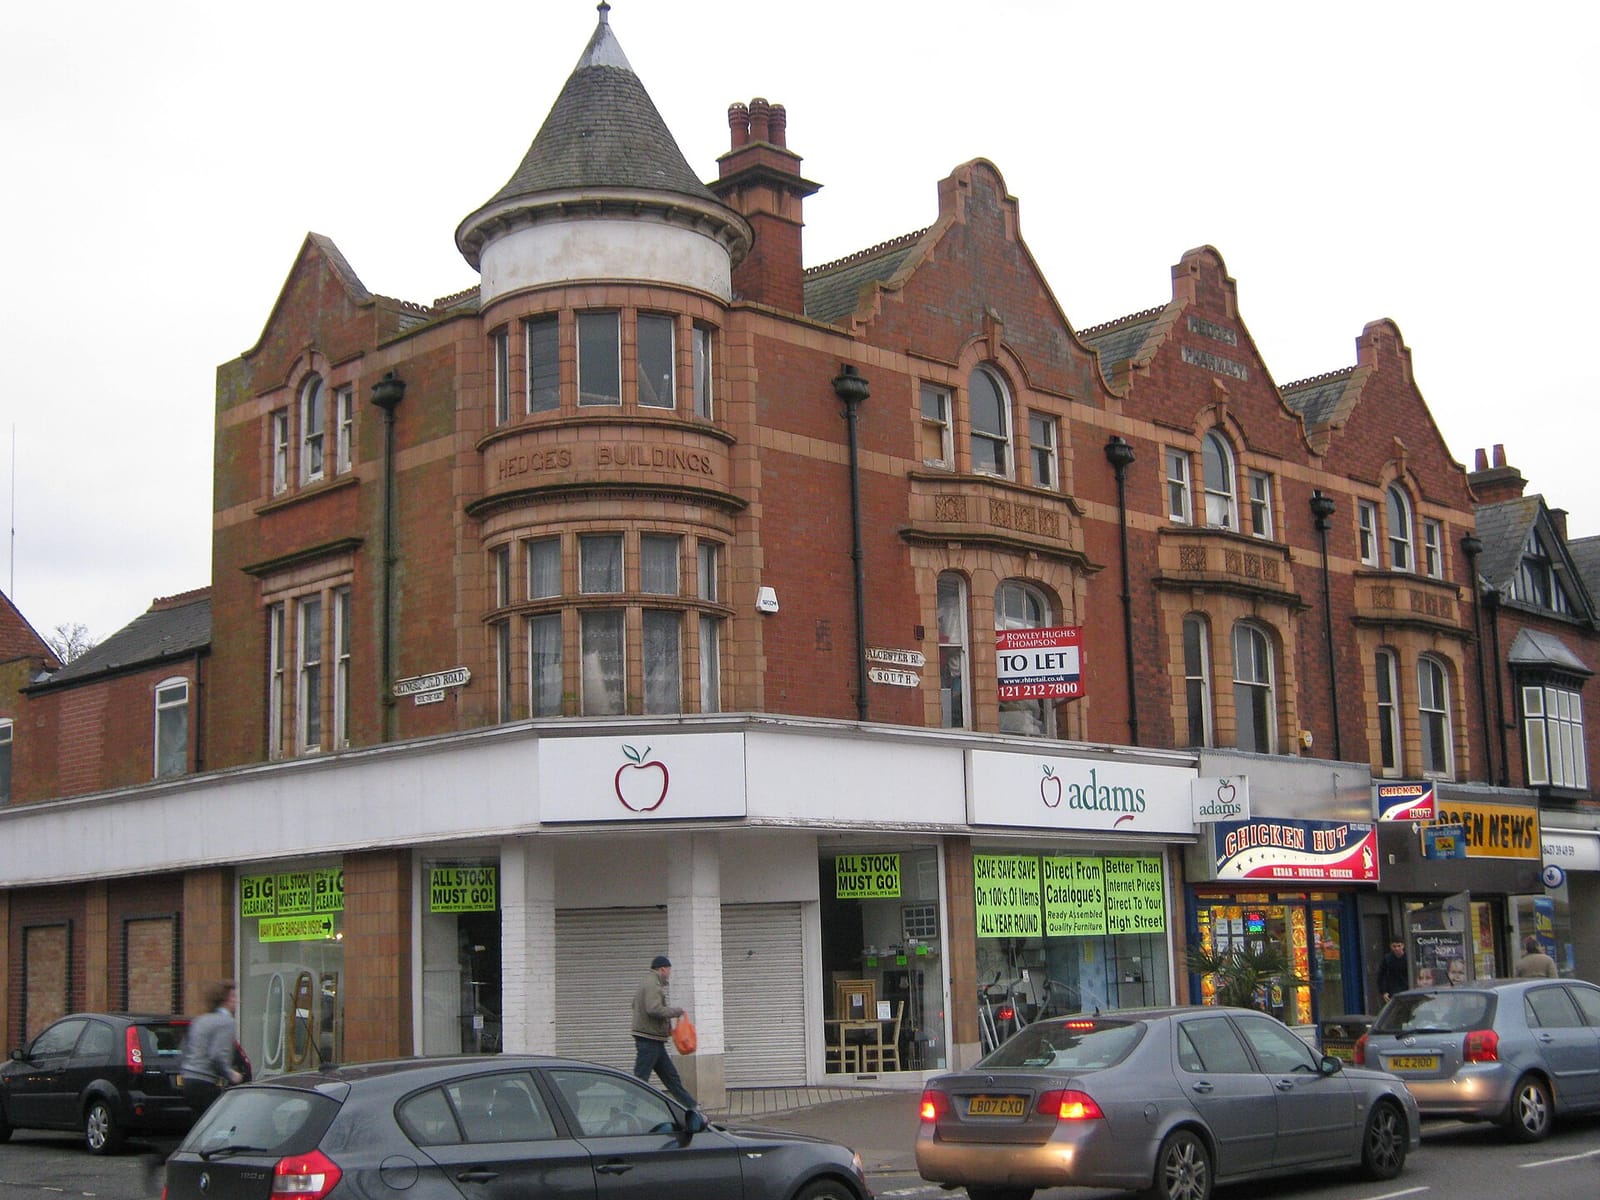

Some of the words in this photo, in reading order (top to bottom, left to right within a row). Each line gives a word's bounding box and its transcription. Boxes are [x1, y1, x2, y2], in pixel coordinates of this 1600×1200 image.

[498, 450, 572, 479] HEDGES
[1006, 631, 1040, 641] ROWLEY
[1042, 630, 1076, 639] HUGHES
[1007, 639, 1057, 648] THOMPSON
[1000, 654, 1028, 672] TO
[1035, 652, 1067, 670] LET
[398, 676, 440, 694] KINGSELD
[443, 672, 464, 685] ROAD
[877, 671, 911, 685] SOUTH
[1024, 684, 1045, 697] 212
[1049, 682, 1078, 695] 7800
[1069, 768, 1146, 813] adams
[1380, 785, 1422, 797] CHICKEN
[1199, 800, 1241, 816] adams
[1409, 808, 1432, 818] HUT
[1489, 813, 1533, 849] NEWS
[1225, 823, 1305, 858] CHICKEN
[1312, 824, 1348, 851] HUT
[838, 857, 857, 872] ALL
[861, 856, 897, 872] STOCK
[977, 860, 995, 878] SAVE
[998, 860, 1015, 879] SAVE
[1018, 861, 1036, 879] SAVE
[1045, 861, 1073, 879] Direct
[1076, 861, 1100, 879] From
[1106, 860, 1134, 873] Better
[1136, 860, 1159, 873] Than
[280, 876, 289, 890] ALL
[291, 873, 310, 889] STOCK
[433, 871, 452, 886] ALL
[456, 869, 493, 885] STOCK
[839, 875, 872, 890] MUST
[876, 874, 897, 889] GO!
[1107, 879, 1135, 892] Internet
[1137, 879, 1160, 891] Price's
[244, 877, 272, 898] BIG
[1046, 884, 1101, 907] Catalogue's
[279, 892, 296, 906] MUST
[299, 889, 310, 905] GO!
[433, 888, 467, 904] MUST
[471, 888, 493, 903] GO!
[977, 887, 987, 906] On
[989, 888, 1007, 906] 100's
[1009, 887, 1017, 906] Of
[1019, 888, 1039, 906] Items
[1108, 897, 1131, 910] Direct
[1133, 897, 1142, 909] To
[1144, 896, 1161, 909] Your
[244, 900, 273, 914] CLEARANCE
[1048, 911, 1067, 920] Ready
[1069, 910, 1102, 919] Assembled
[981, 914, 993, 932] ALL
[995, 914, 1012, 932] YEAR
[1014, 914, 1037, 932] ROUND
[1049, 923, 1072, 933] Quality
[1074, 922, 1103, 931] Furniture
[1109, 915, 1131, 931] High
[1134, 915, 1162, 928] Street
[970, 1100, 997, 1113] LB07
